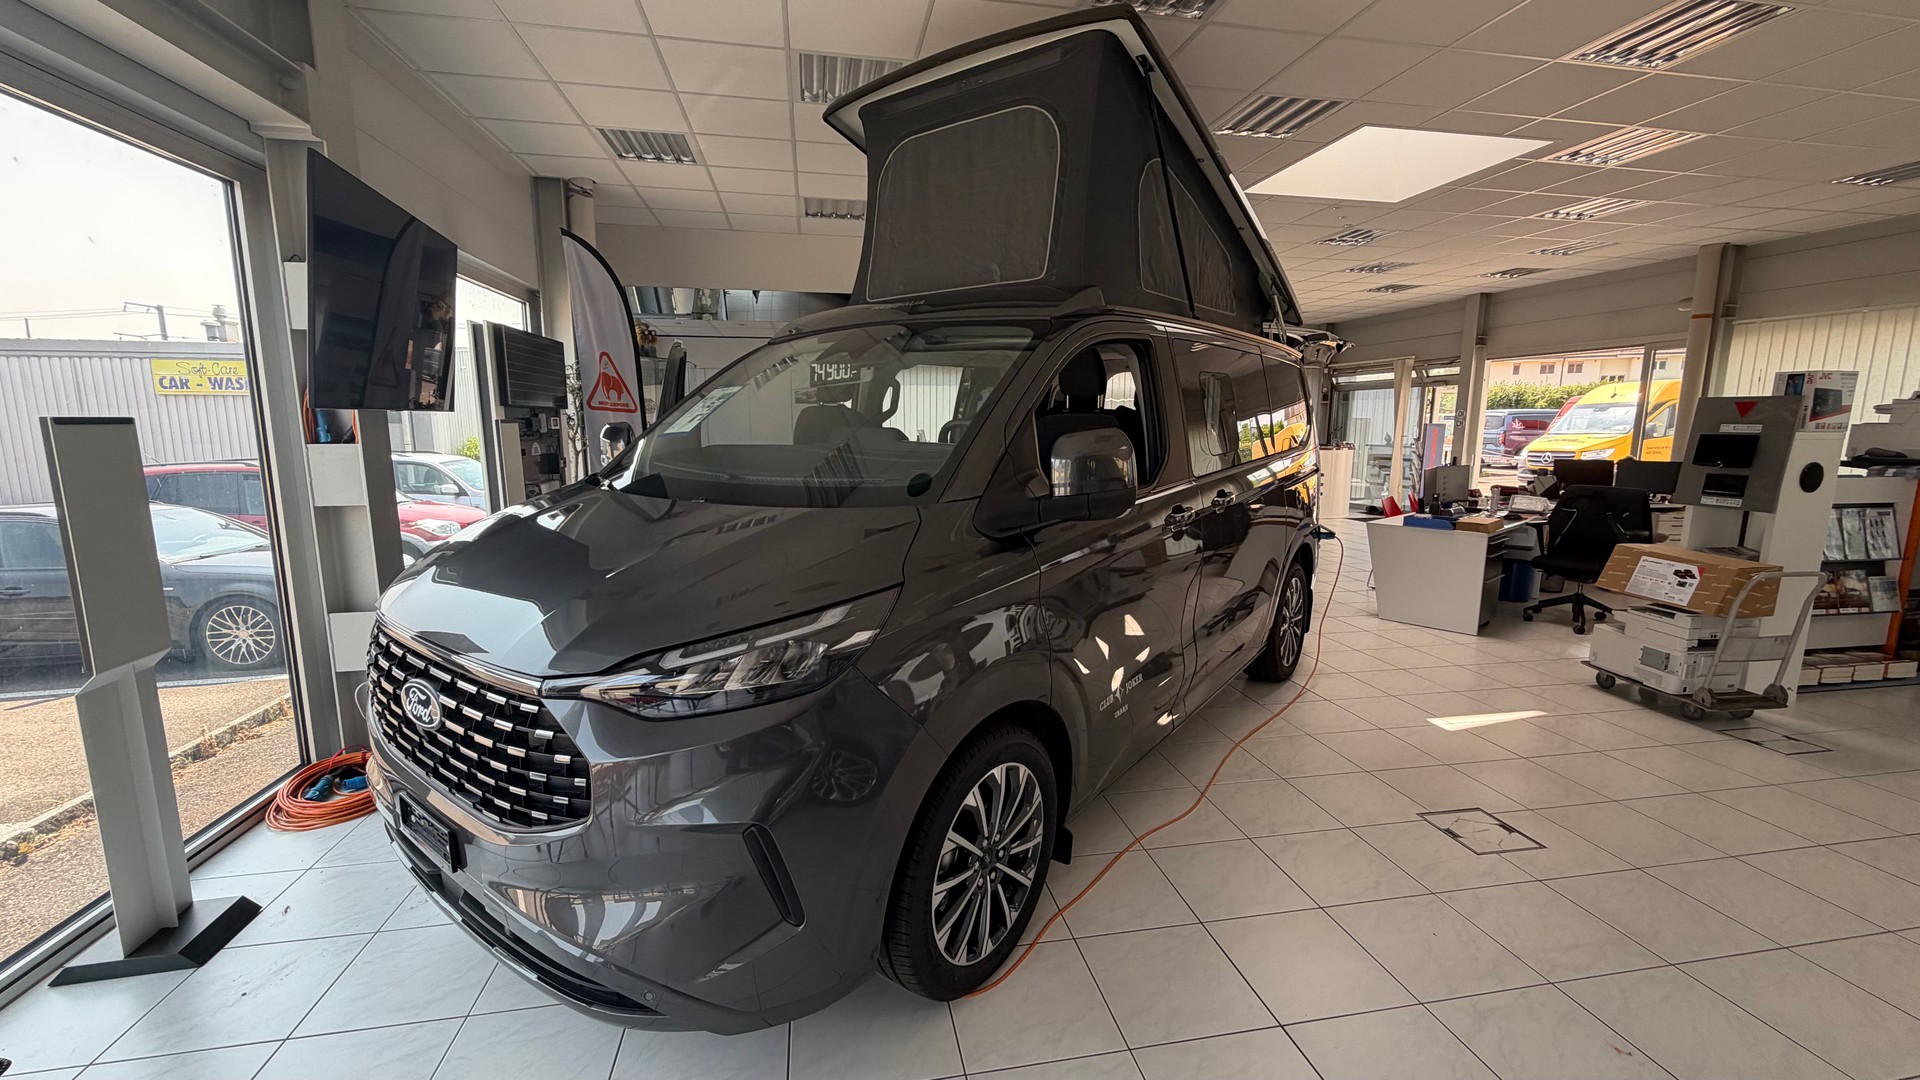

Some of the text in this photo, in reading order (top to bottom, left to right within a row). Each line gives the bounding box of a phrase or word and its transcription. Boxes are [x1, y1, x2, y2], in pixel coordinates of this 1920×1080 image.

[175, 361, 239, 379] Soft-Care
[1818, 372, 1833, 380] JVC
[158, 375, 191, 390] CAR
[1099, 673, 1144, 711] CLUB JOKER
[406, 687, 433, 723] Ford
